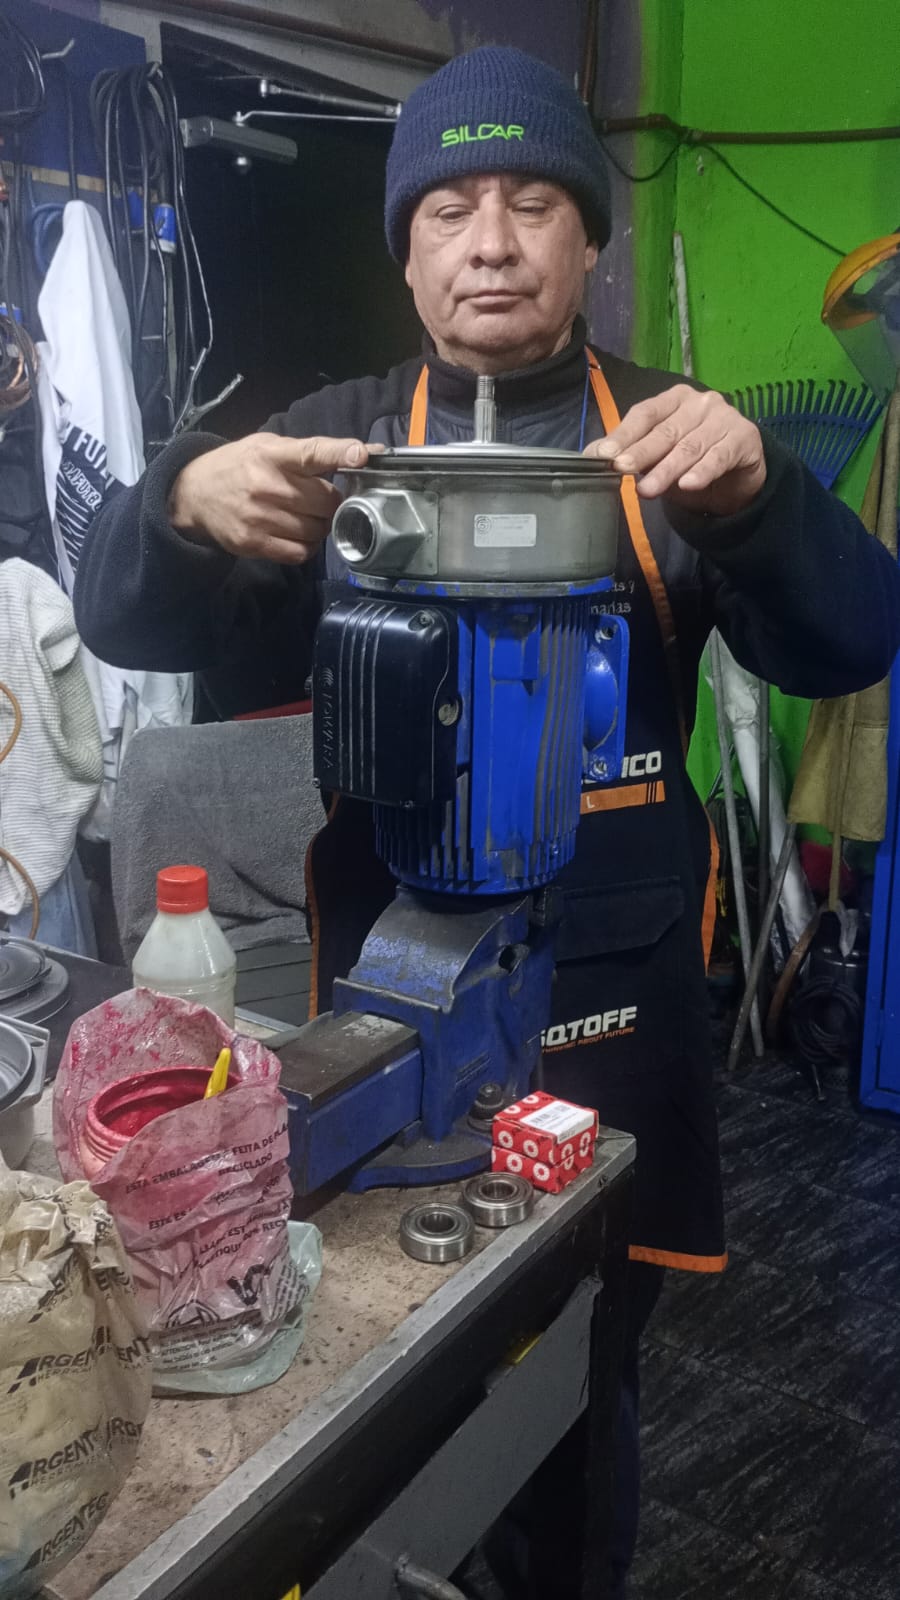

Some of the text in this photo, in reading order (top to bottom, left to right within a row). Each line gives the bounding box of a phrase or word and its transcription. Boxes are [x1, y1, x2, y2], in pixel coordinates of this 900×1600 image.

[441, 123, 524, 148] SILCAR
[232, 1143, 261, 1156] FEITA
[262, 1136, 274, 1149] DE
[218, 1152, 273, 1177] RECICLADO
